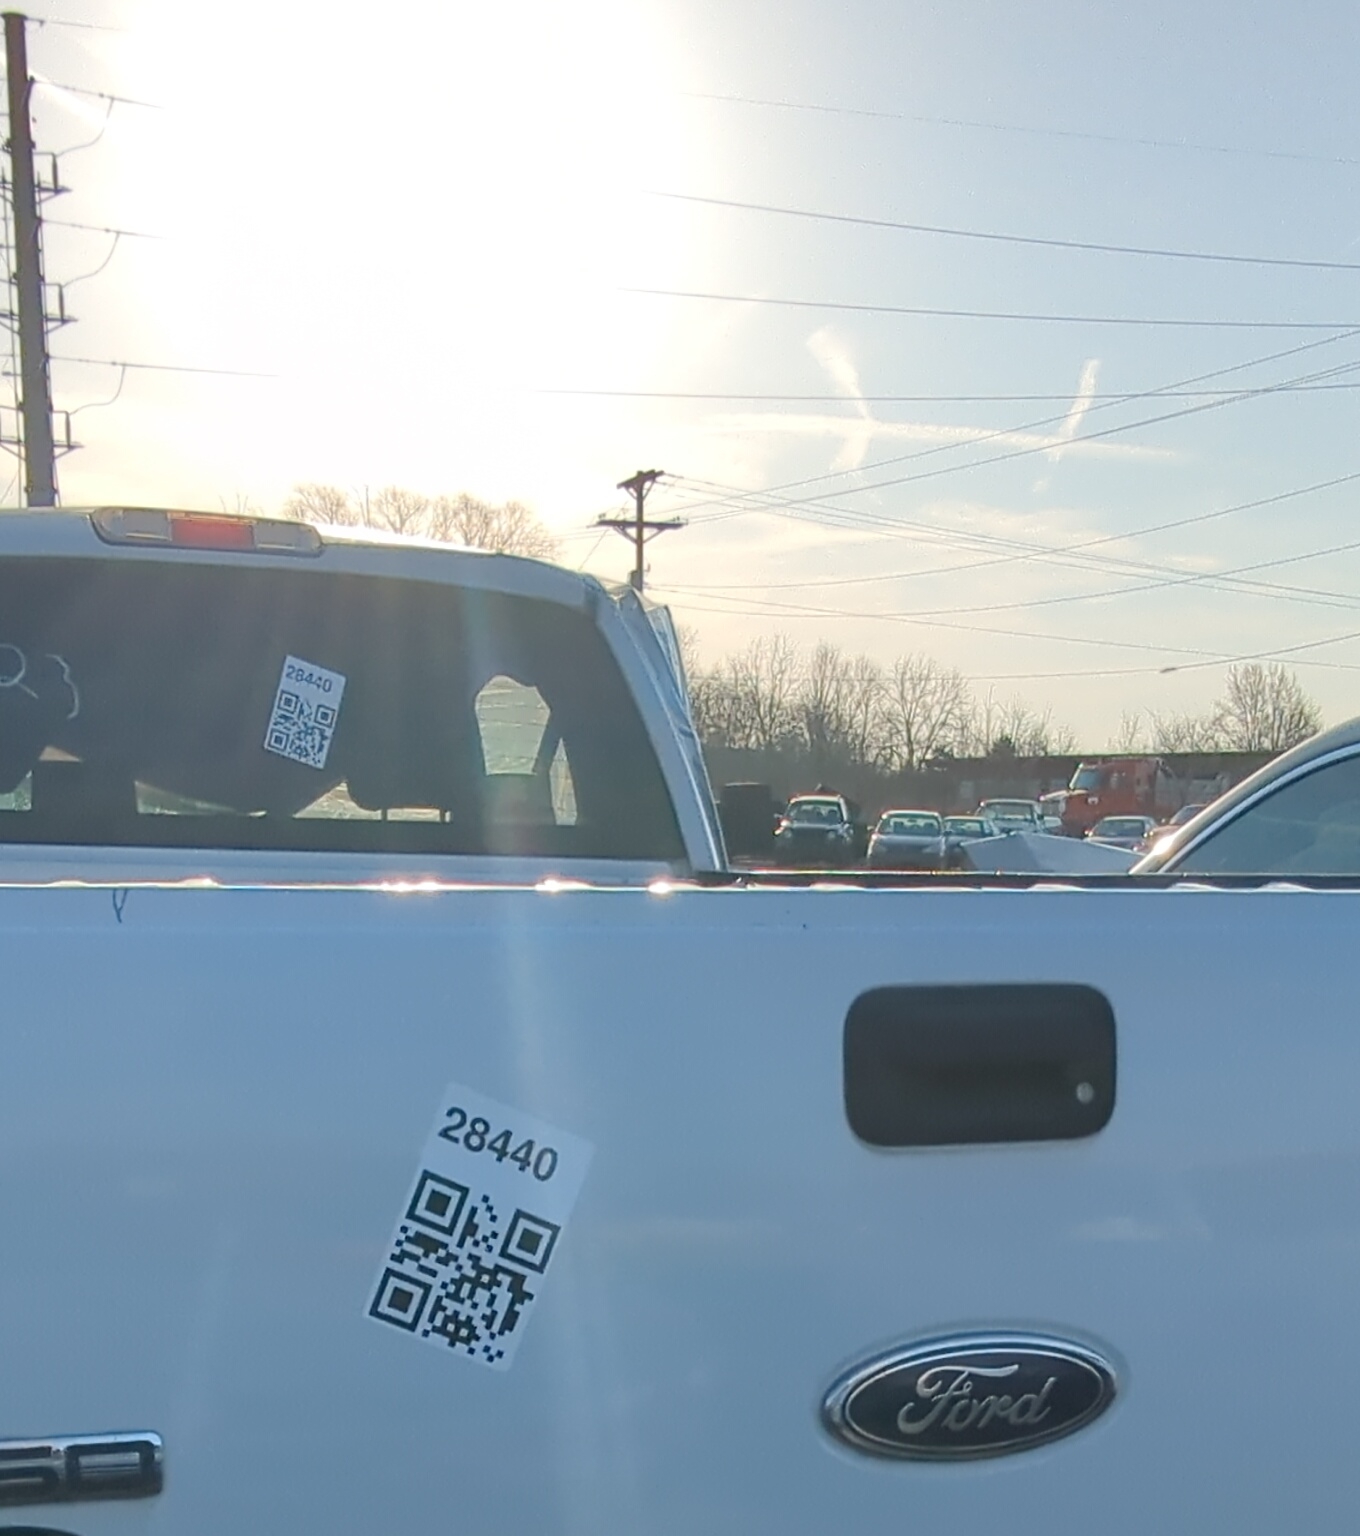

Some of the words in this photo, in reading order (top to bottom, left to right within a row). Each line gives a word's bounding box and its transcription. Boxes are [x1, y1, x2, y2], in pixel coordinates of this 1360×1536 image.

[285, 664, 333, 693] 28440
[437, 1105, 559, 1183] 28440
[896, 1363, 1057, 1435] Ford
